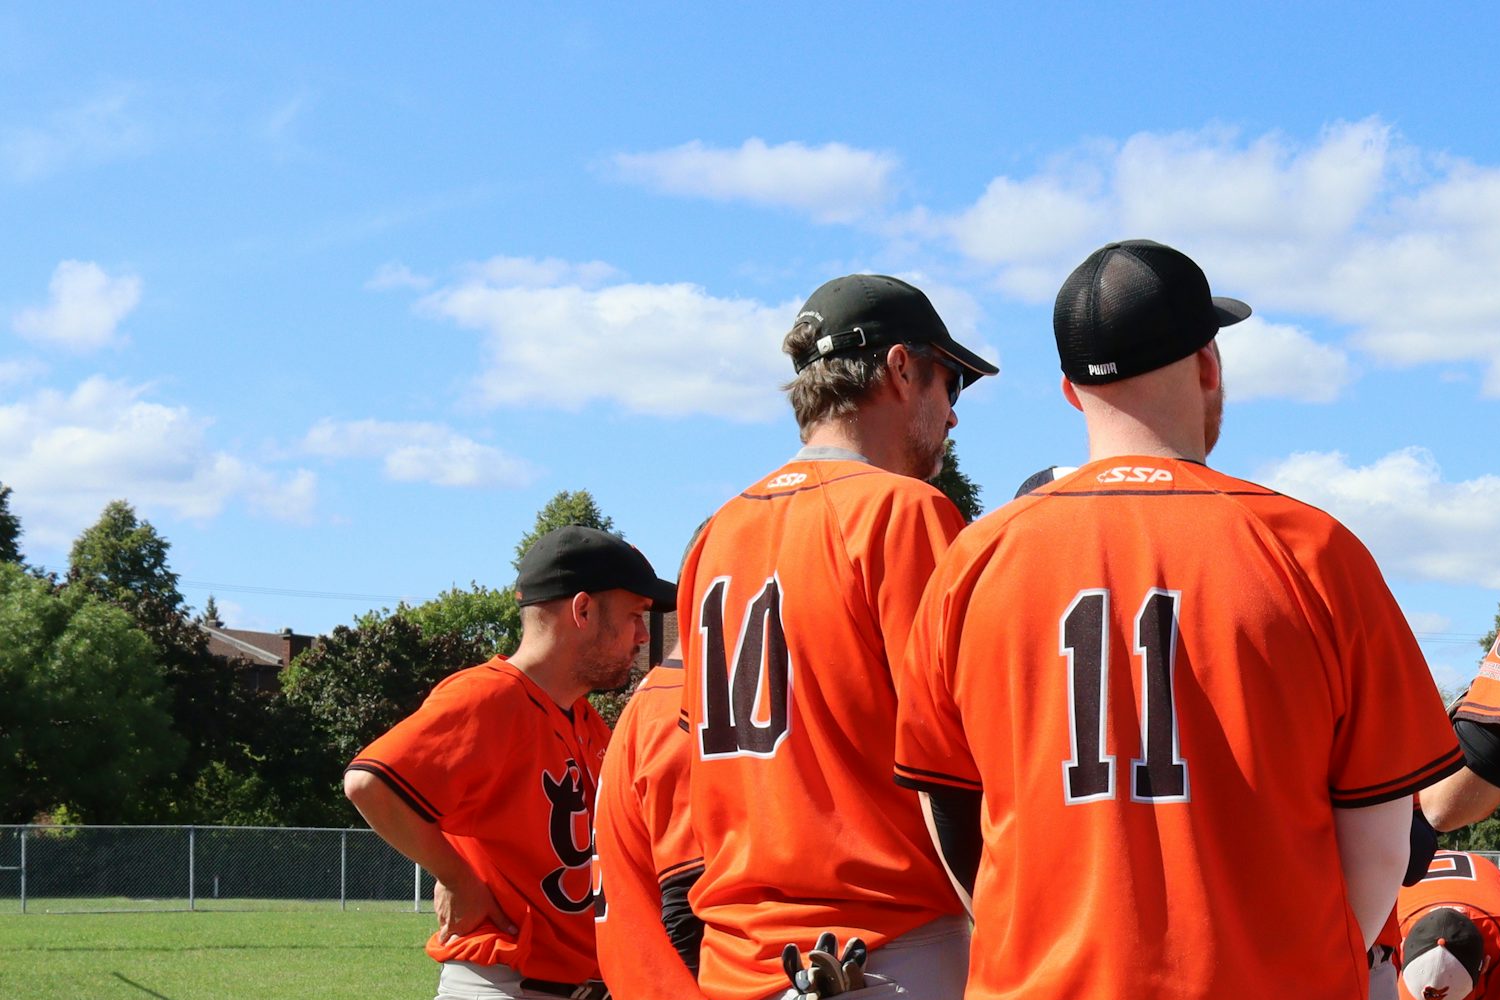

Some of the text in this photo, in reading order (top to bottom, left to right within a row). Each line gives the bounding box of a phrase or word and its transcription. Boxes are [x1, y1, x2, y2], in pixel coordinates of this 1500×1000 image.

[1088, 362, 1118, 376] PUMA
[1103, 466, 1174, 483] SSP
[698, 570, 793, 761] 10
[1058, 587, 1191, 806] 11
